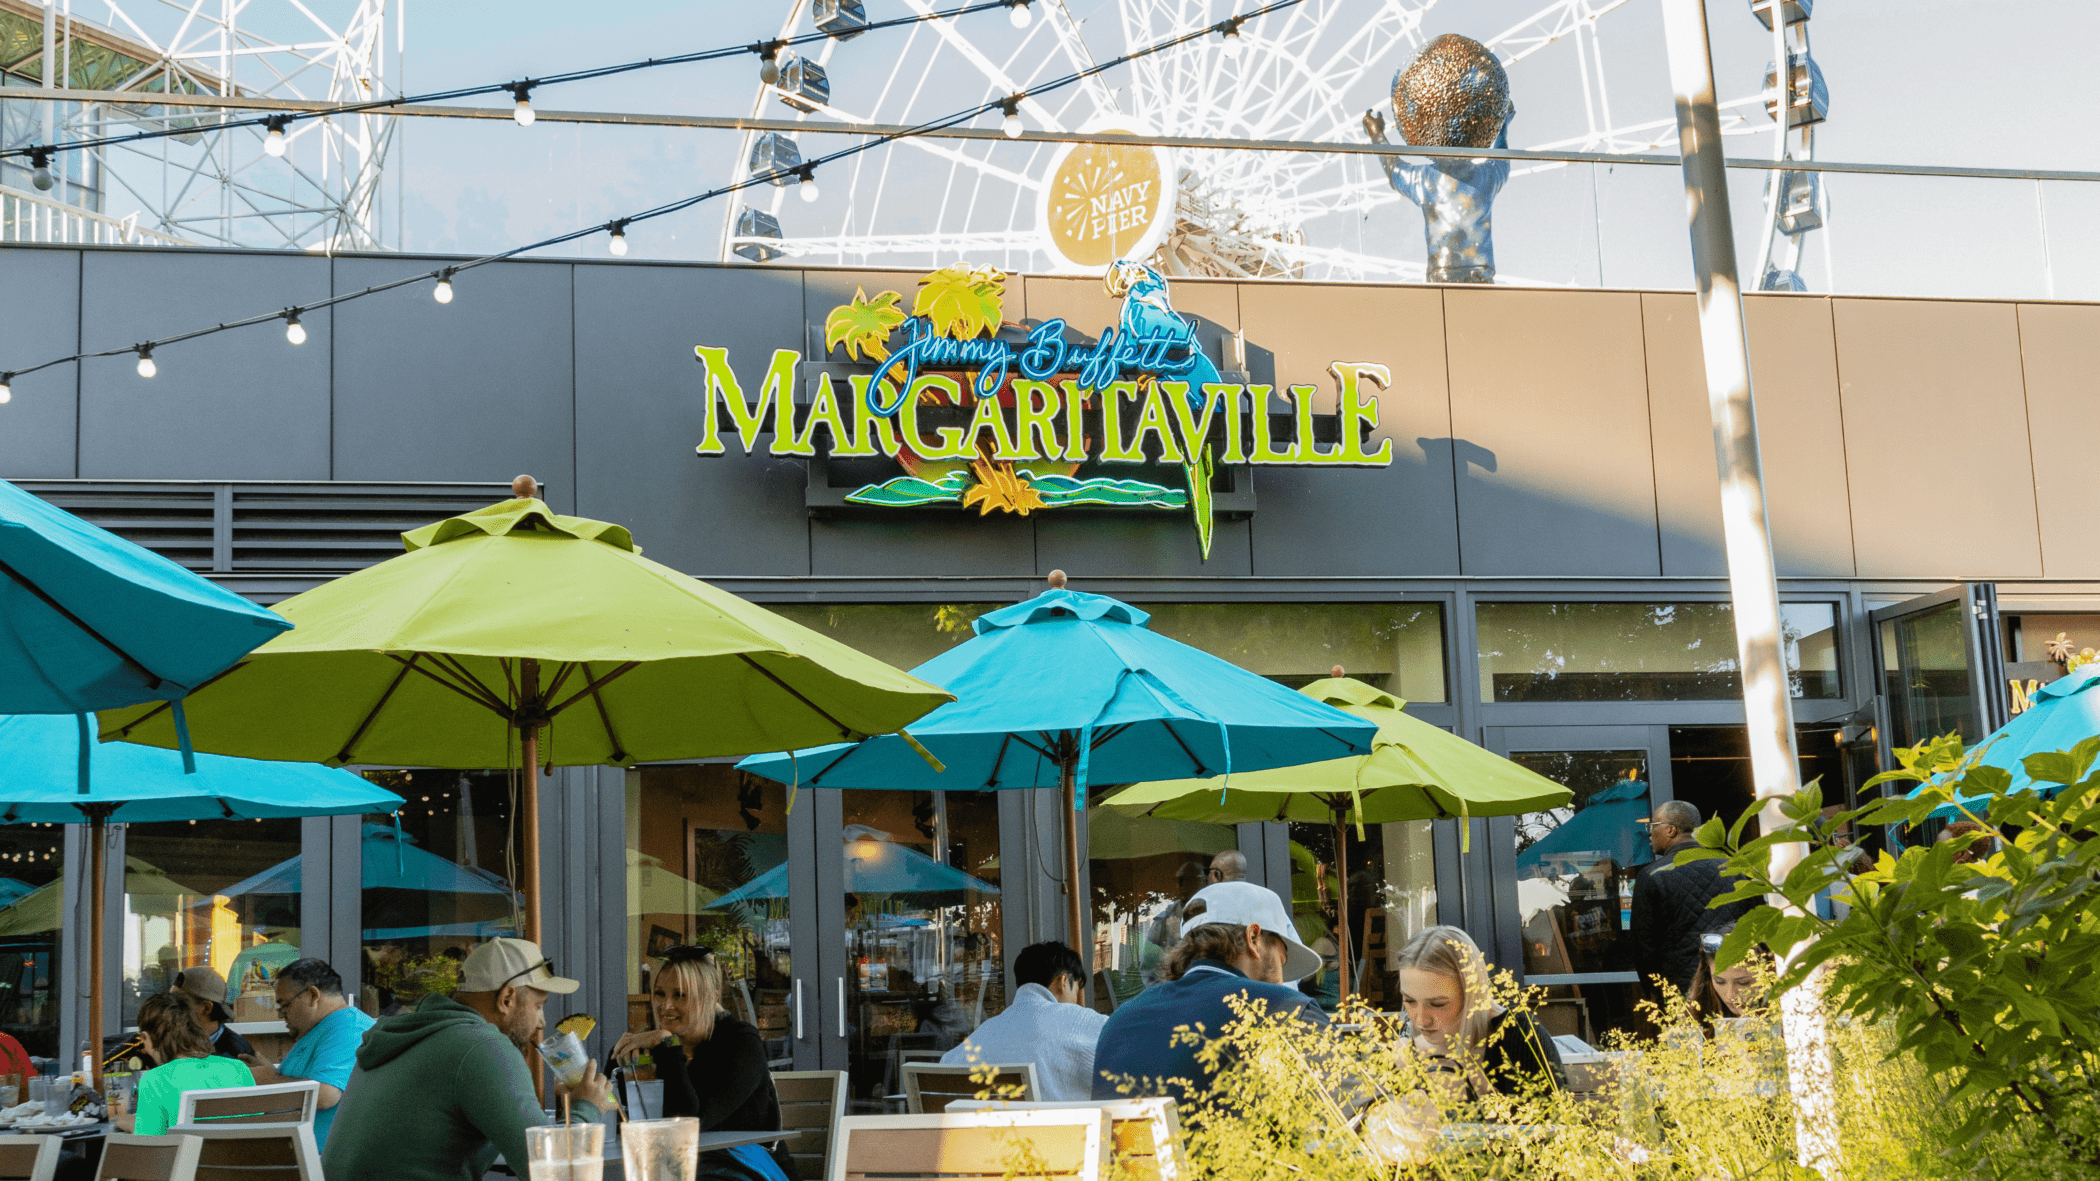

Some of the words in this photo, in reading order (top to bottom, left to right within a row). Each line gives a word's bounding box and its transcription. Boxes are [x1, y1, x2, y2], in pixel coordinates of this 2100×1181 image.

[1090, 180, 1151, 217] NAVY
[1091, 205, 1148, 239] PIER
[866, 315, 1016, 417] Jimmy
[695, 344, 1393, 466] MARGARITAVILLE
